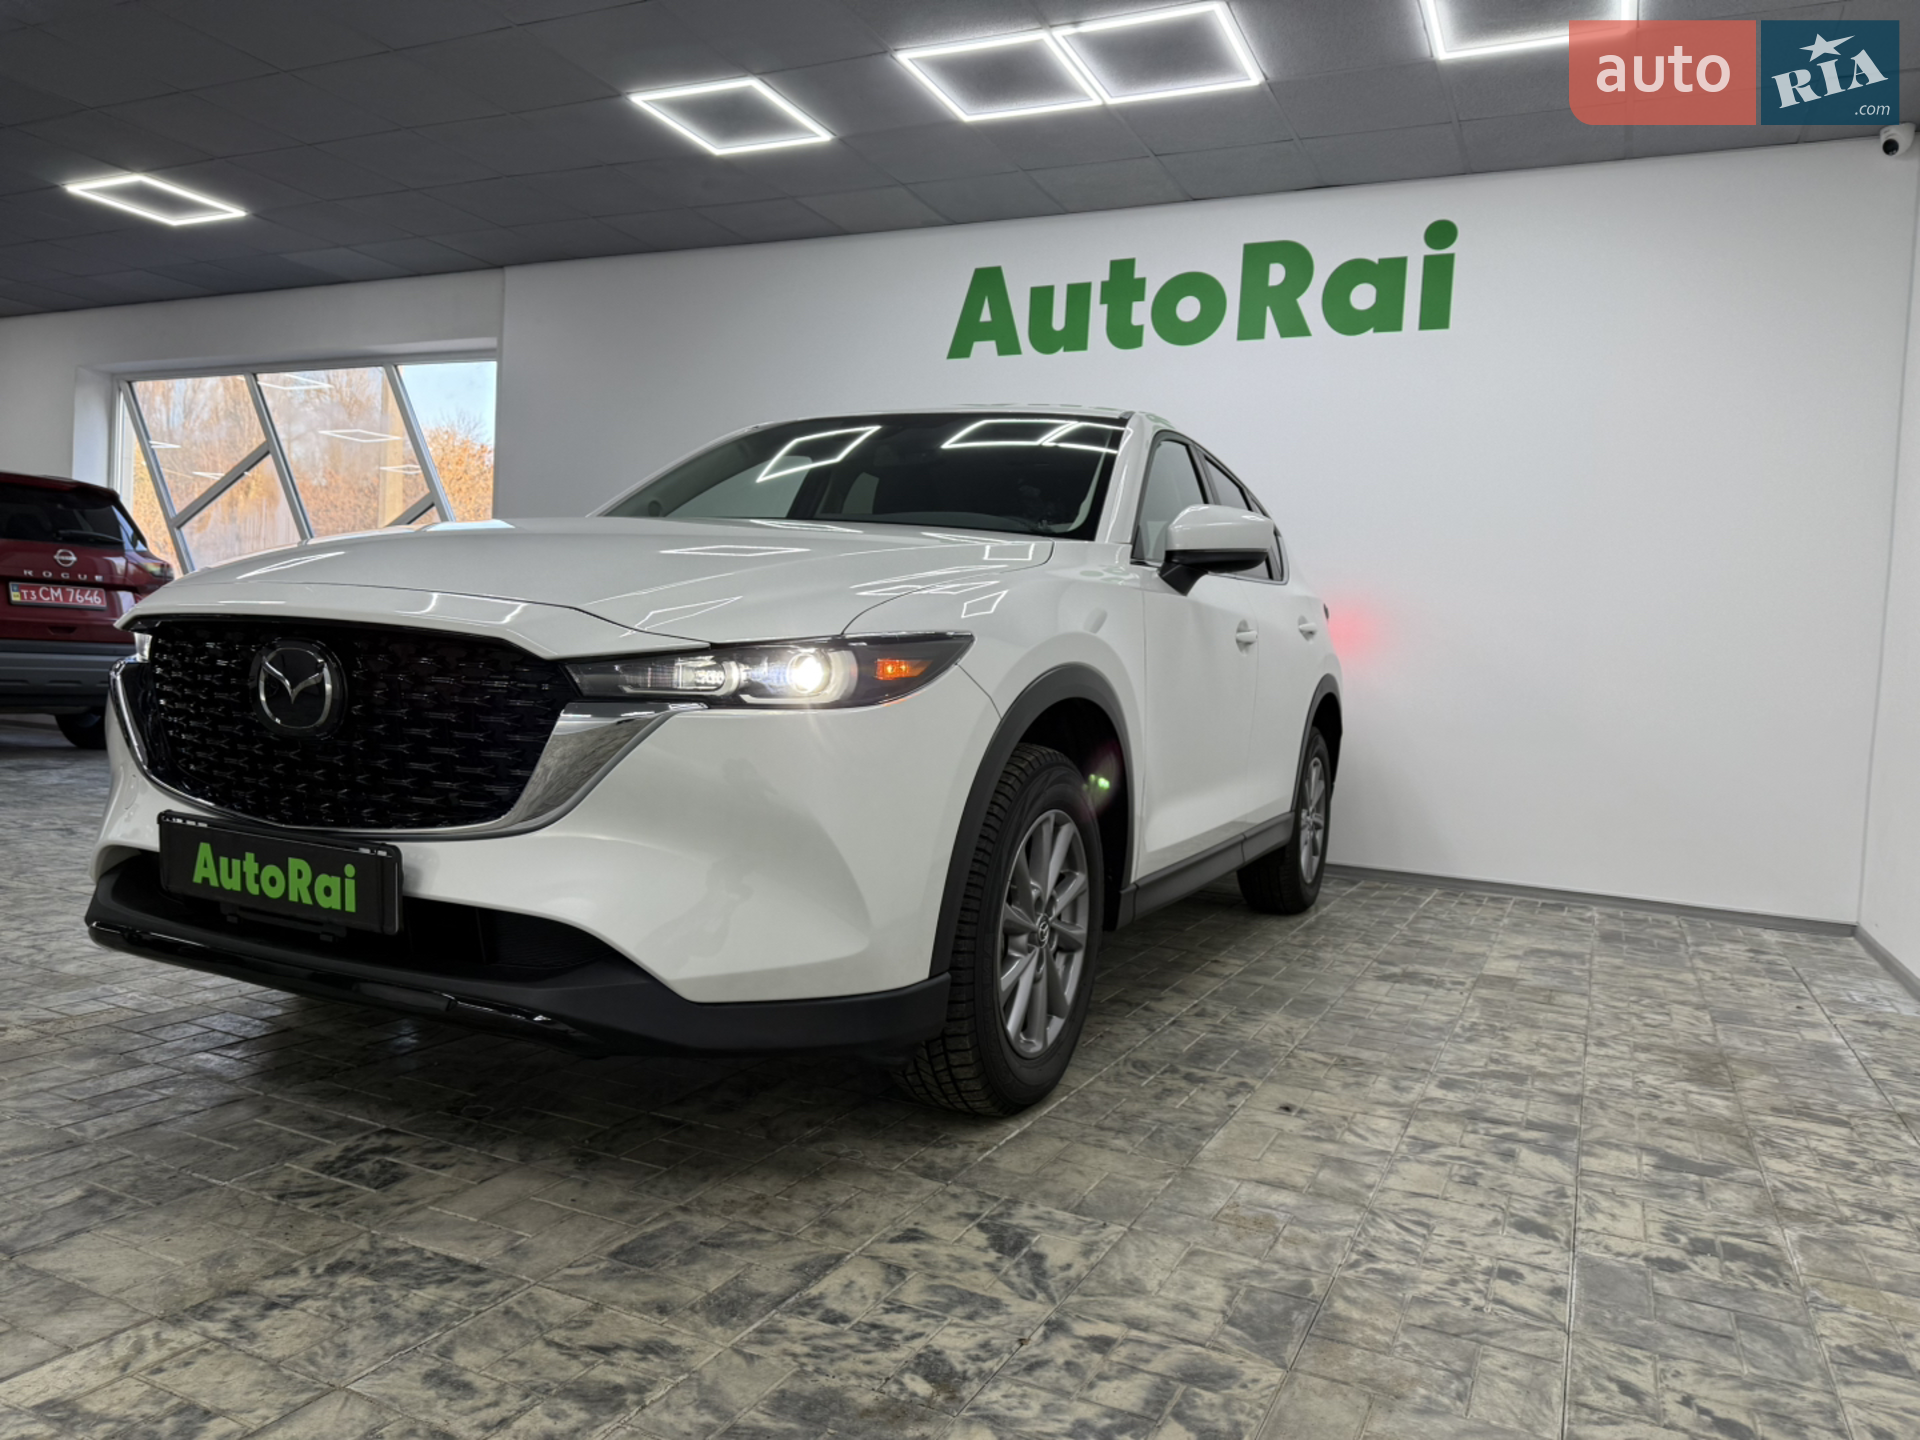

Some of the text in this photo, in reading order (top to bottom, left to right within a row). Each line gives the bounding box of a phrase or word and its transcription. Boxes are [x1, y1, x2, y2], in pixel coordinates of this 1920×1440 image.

[946, 219, 1458, 360] AutoRai
[24, 570, 103, 582] ROGUE
[39, 587, 63, 602] CM
[66, 588, 102, 604] 7646
[192, 842, 356, 912] AutoRai
